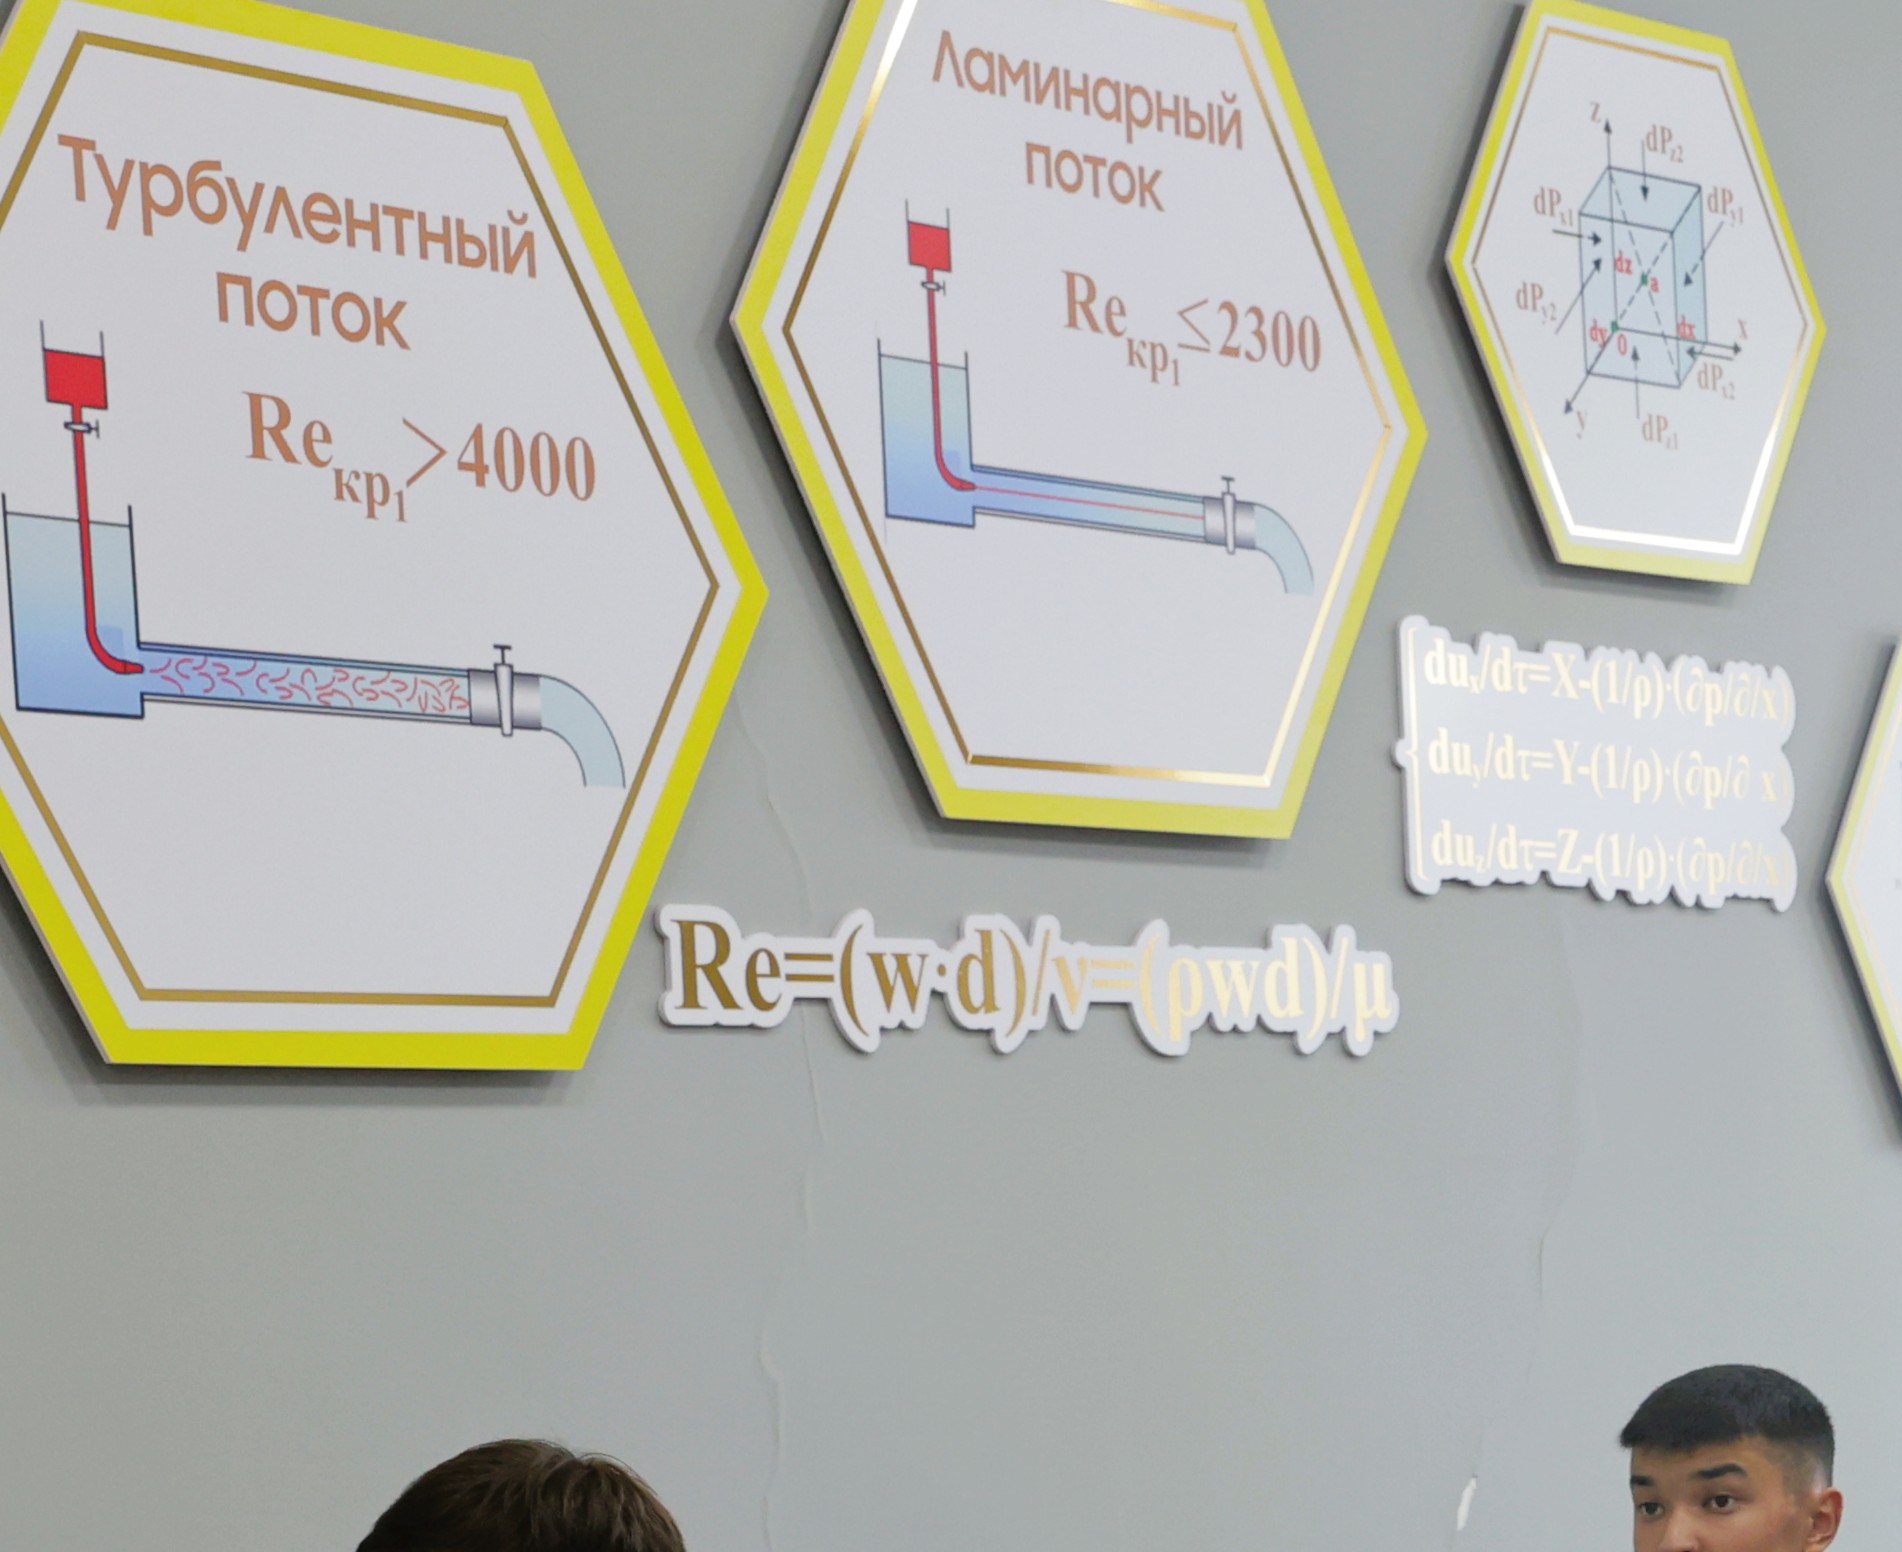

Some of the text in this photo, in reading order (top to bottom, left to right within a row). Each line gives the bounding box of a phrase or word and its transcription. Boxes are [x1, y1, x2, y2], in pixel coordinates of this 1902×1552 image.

[932, 30, 1243, 150] Ламинарный
[58, 133, 537, 279] Турбулентный
[1025, 142, 1164, 212] поток
[216, 271, 411, 351] поток
